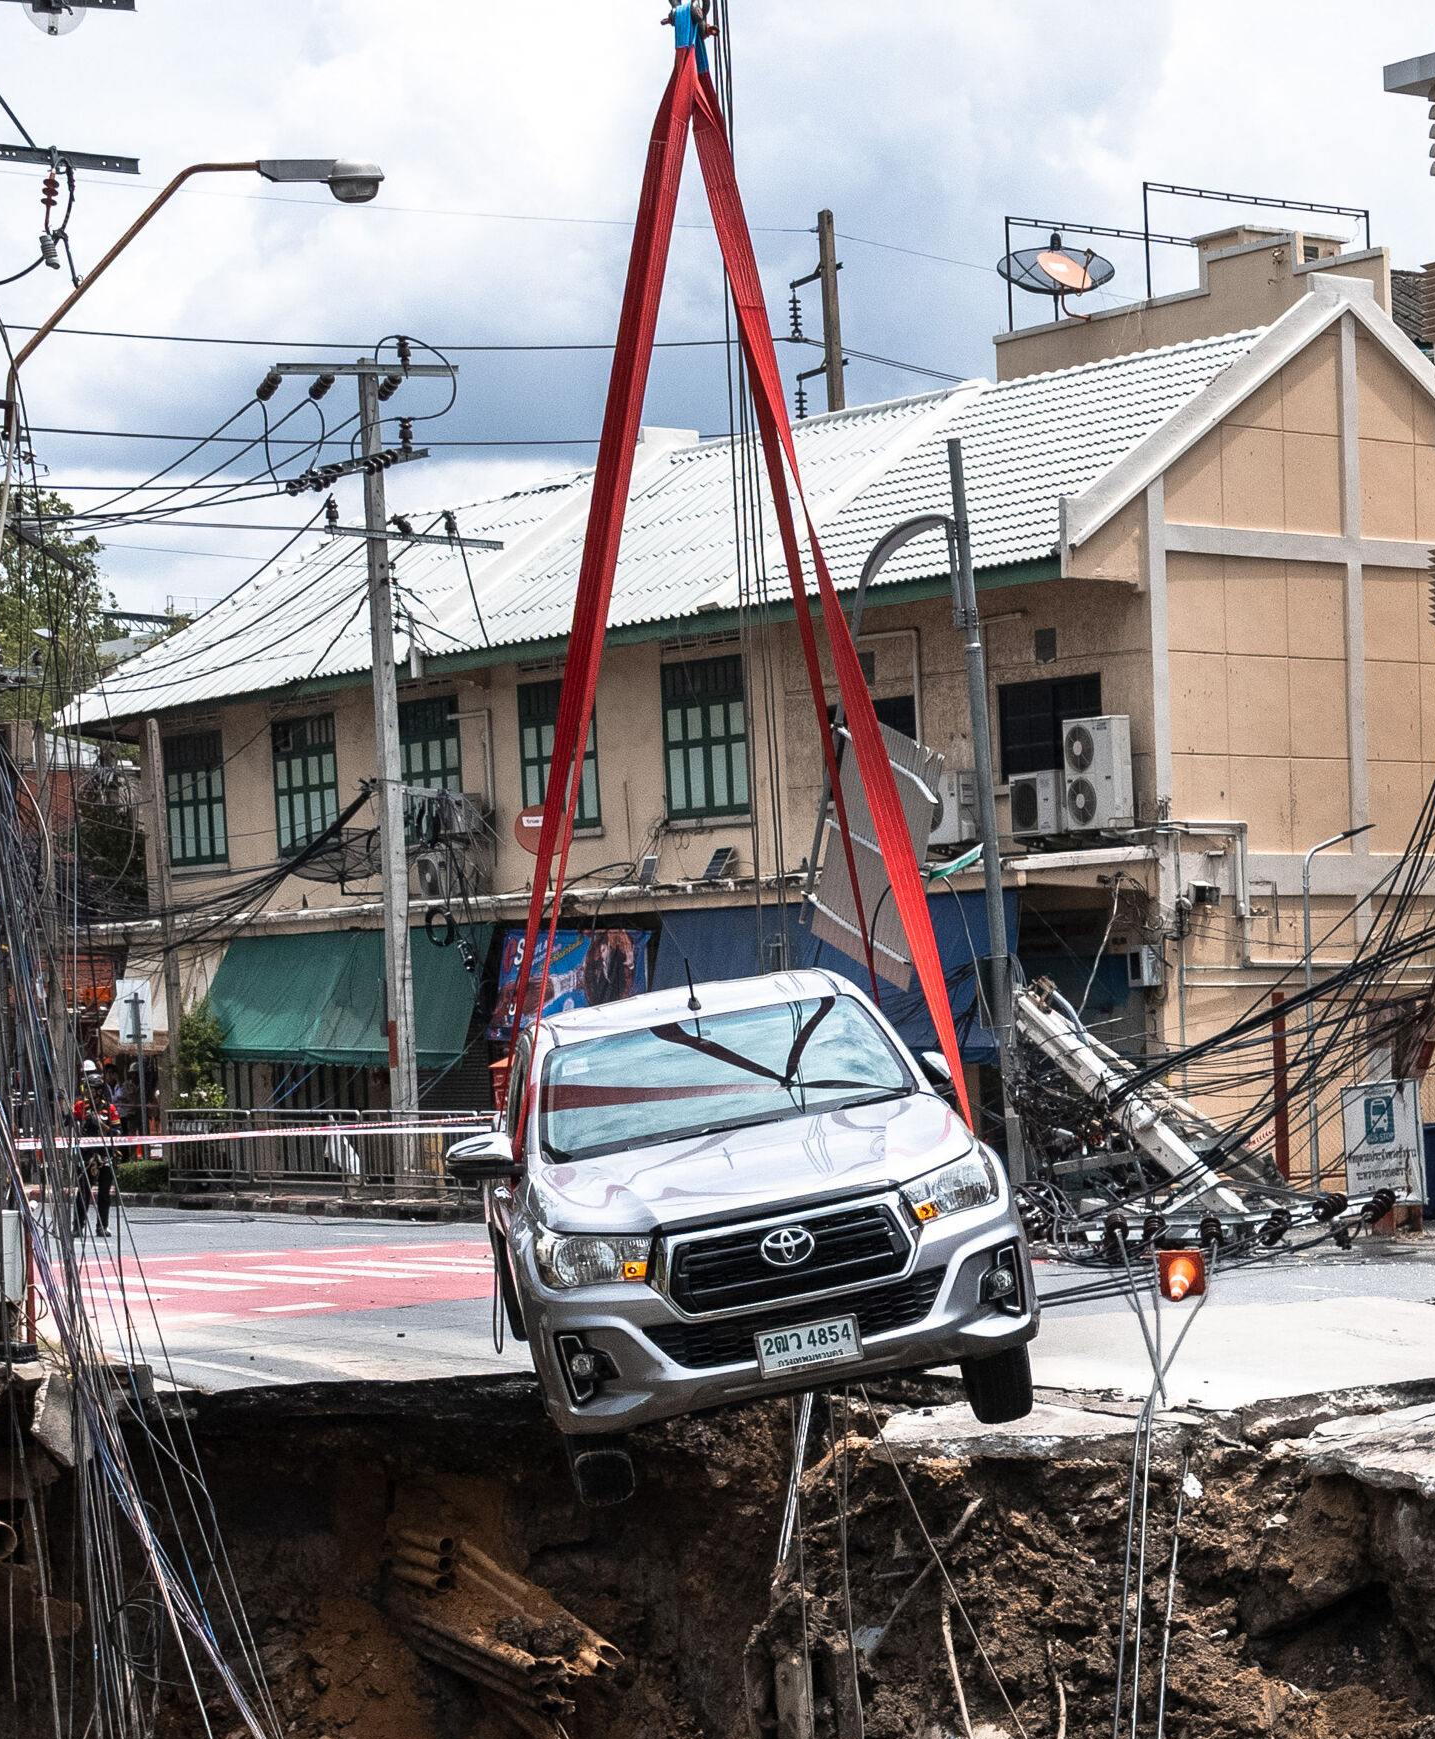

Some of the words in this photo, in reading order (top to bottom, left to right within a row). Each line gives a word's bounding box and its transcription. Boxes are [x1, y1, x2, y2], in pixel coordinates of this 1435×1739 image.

[807, 1323, 852, 1347] 4854
[777, 1348, 843, 1367] กรงเทพมหานคร
